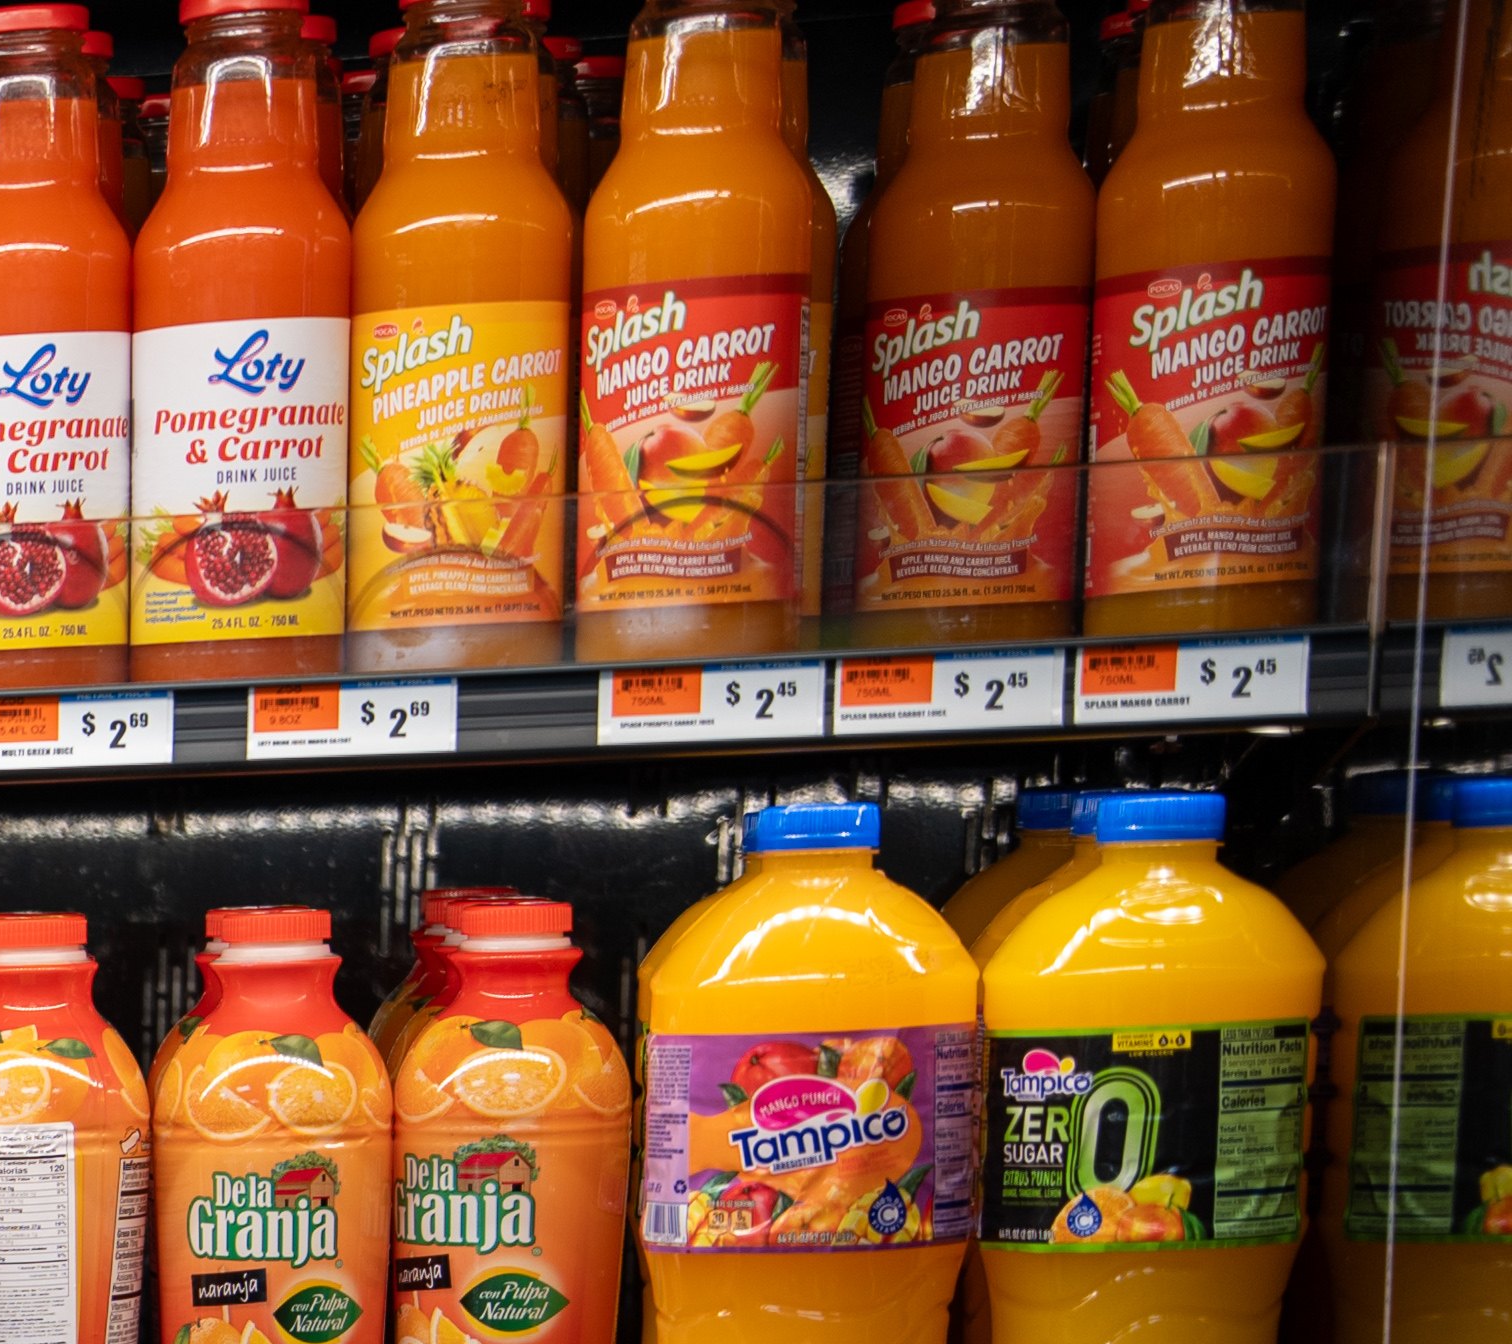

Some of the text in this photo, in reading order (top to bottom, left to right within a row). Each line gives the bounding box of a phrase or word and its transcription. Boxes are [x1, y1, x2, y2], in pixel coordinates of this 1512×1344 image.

[361, 316, 473, 391] Splash
[1151, 307, 1327, 380] MANGO CARROT
[372, 349, 561, 425] PINEAPPLE CARROT
[415, 388, 522, 430] JUICE DRINK
[732, 1108, 907, 1166] Tampico
[1004, 1145, 1063, 1164] SUGAR
[215, 1175, 272, 1208] De la
[189, 1194, 338, 1266] Granja
[200, 1275, 259, 1303] naranja
[292, 1292, 350, 1314] con Pulpa
[291, 1311, 345, 1334] Natural
